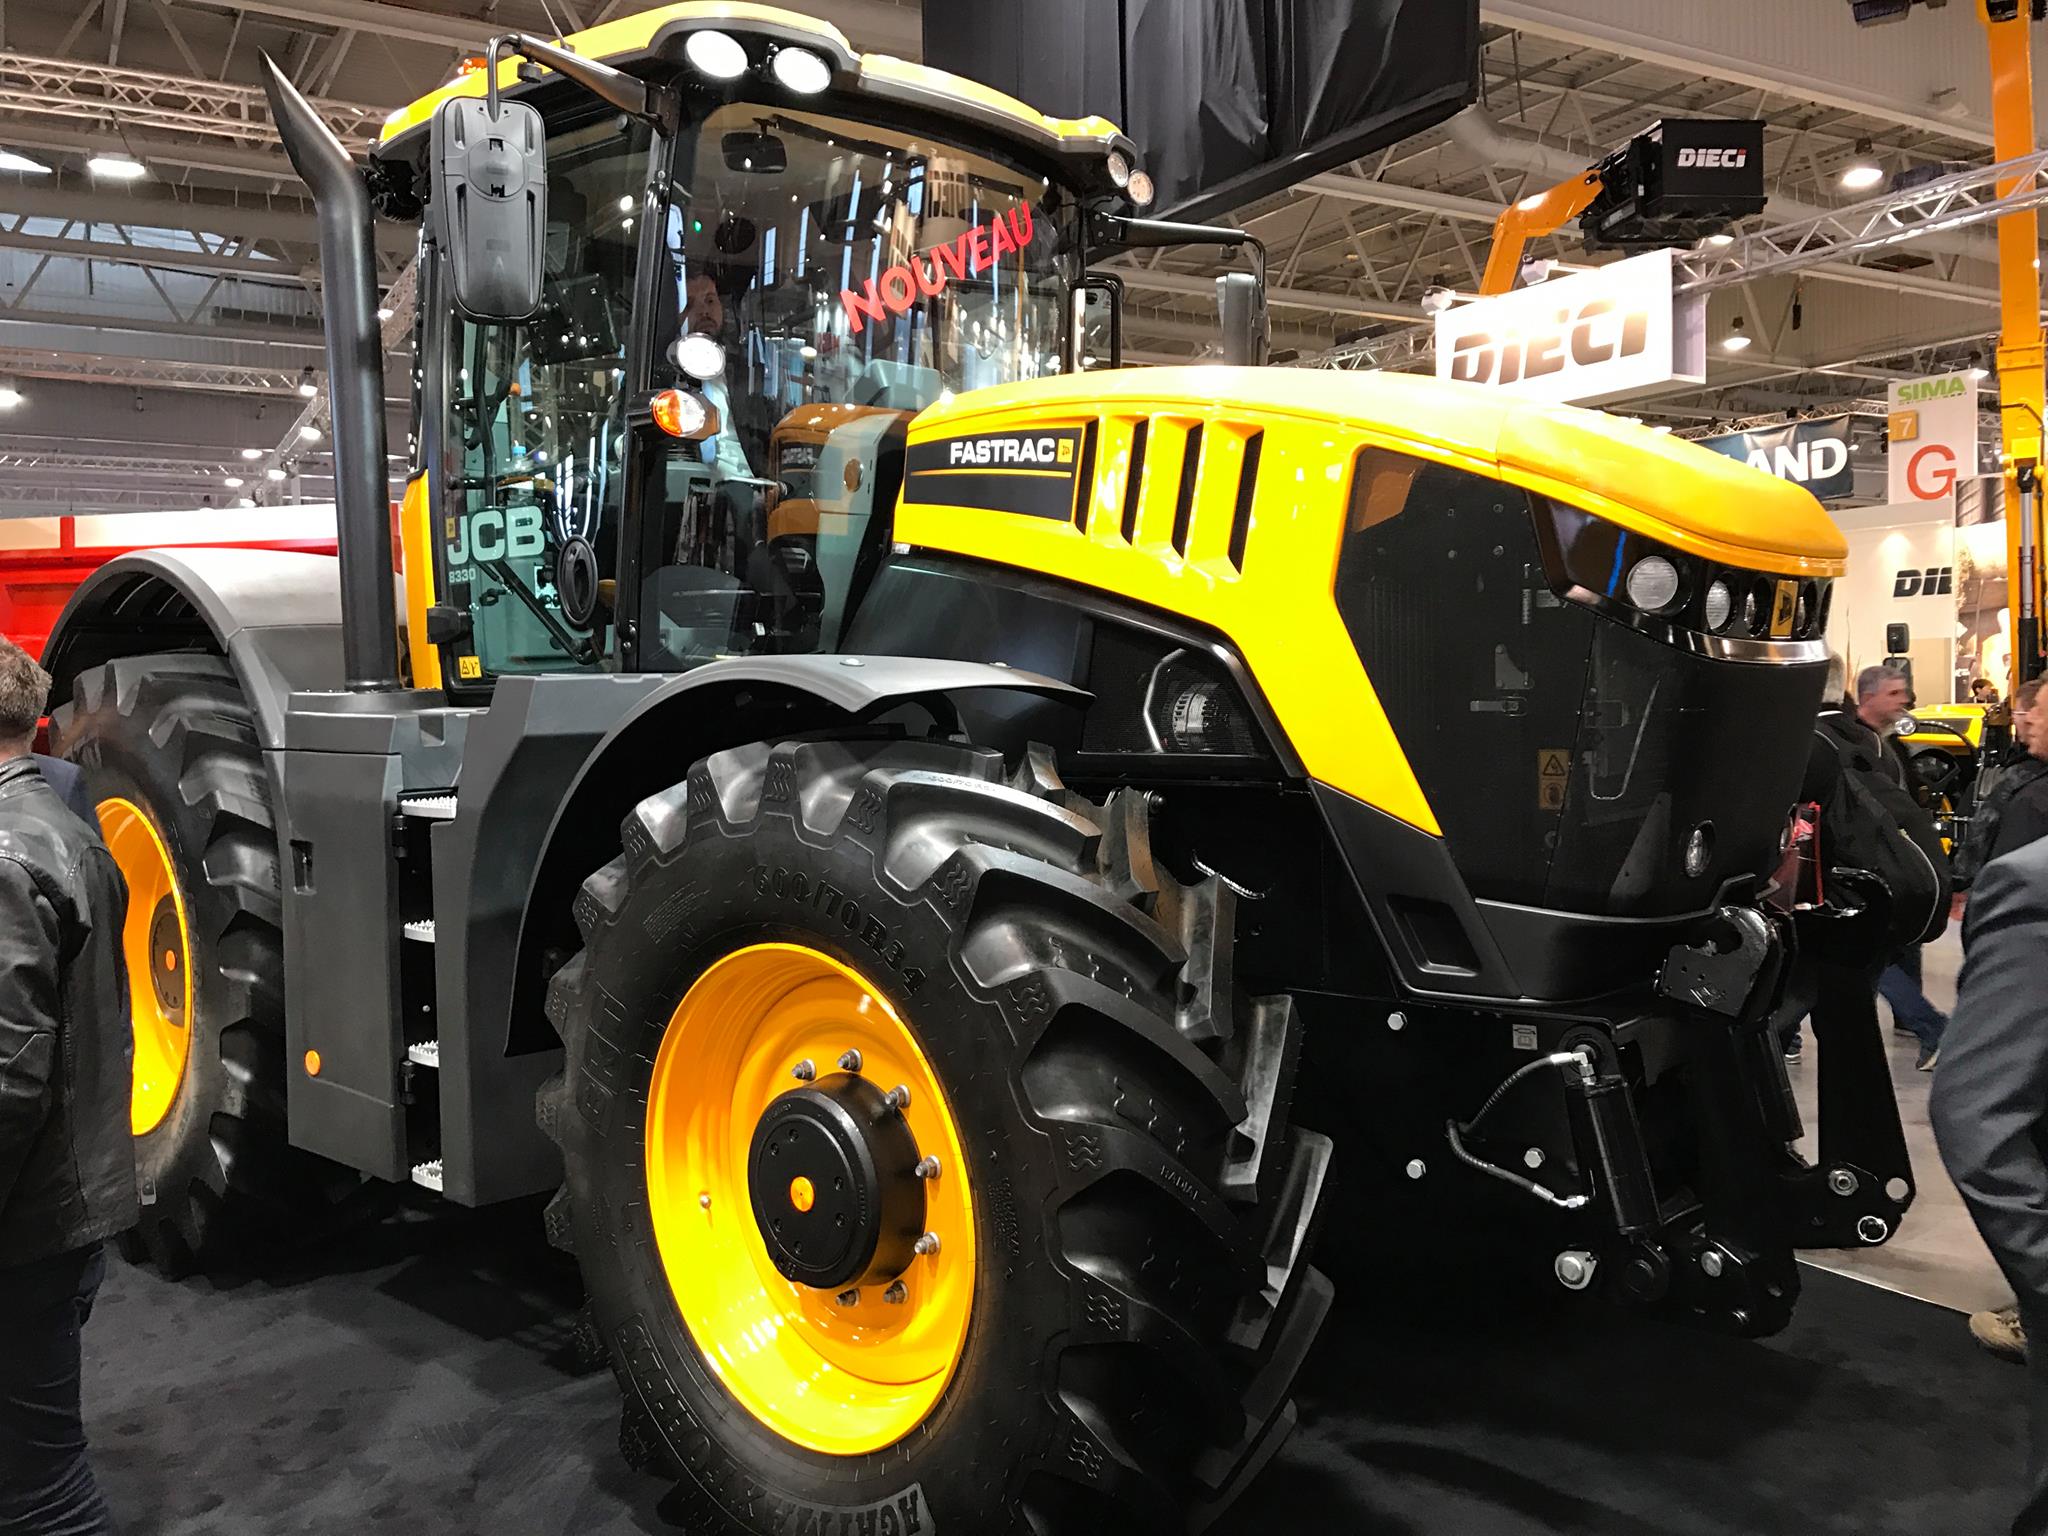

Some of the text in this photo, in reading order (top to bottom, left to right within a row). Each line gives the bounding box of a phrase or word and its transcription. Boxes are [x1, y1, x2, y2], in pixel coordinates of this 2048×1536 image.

[1678, 148, 1747, 168] DIECI
[840, 200, 1033, 333] NOUVEAU
[1451, 301, 1648, 386] DIECI
[1897, 377, 1966, 401] SIMA
[1899, 417, 1913, 438] 7
[950, 437, 1056, 465] FASTRAC
[1722, 437, 1848, 482] AND
[1906, 444, 1958, 501] G
[447, 505, 546, 566] JCB
[449, 567, 477, 583] 8330
